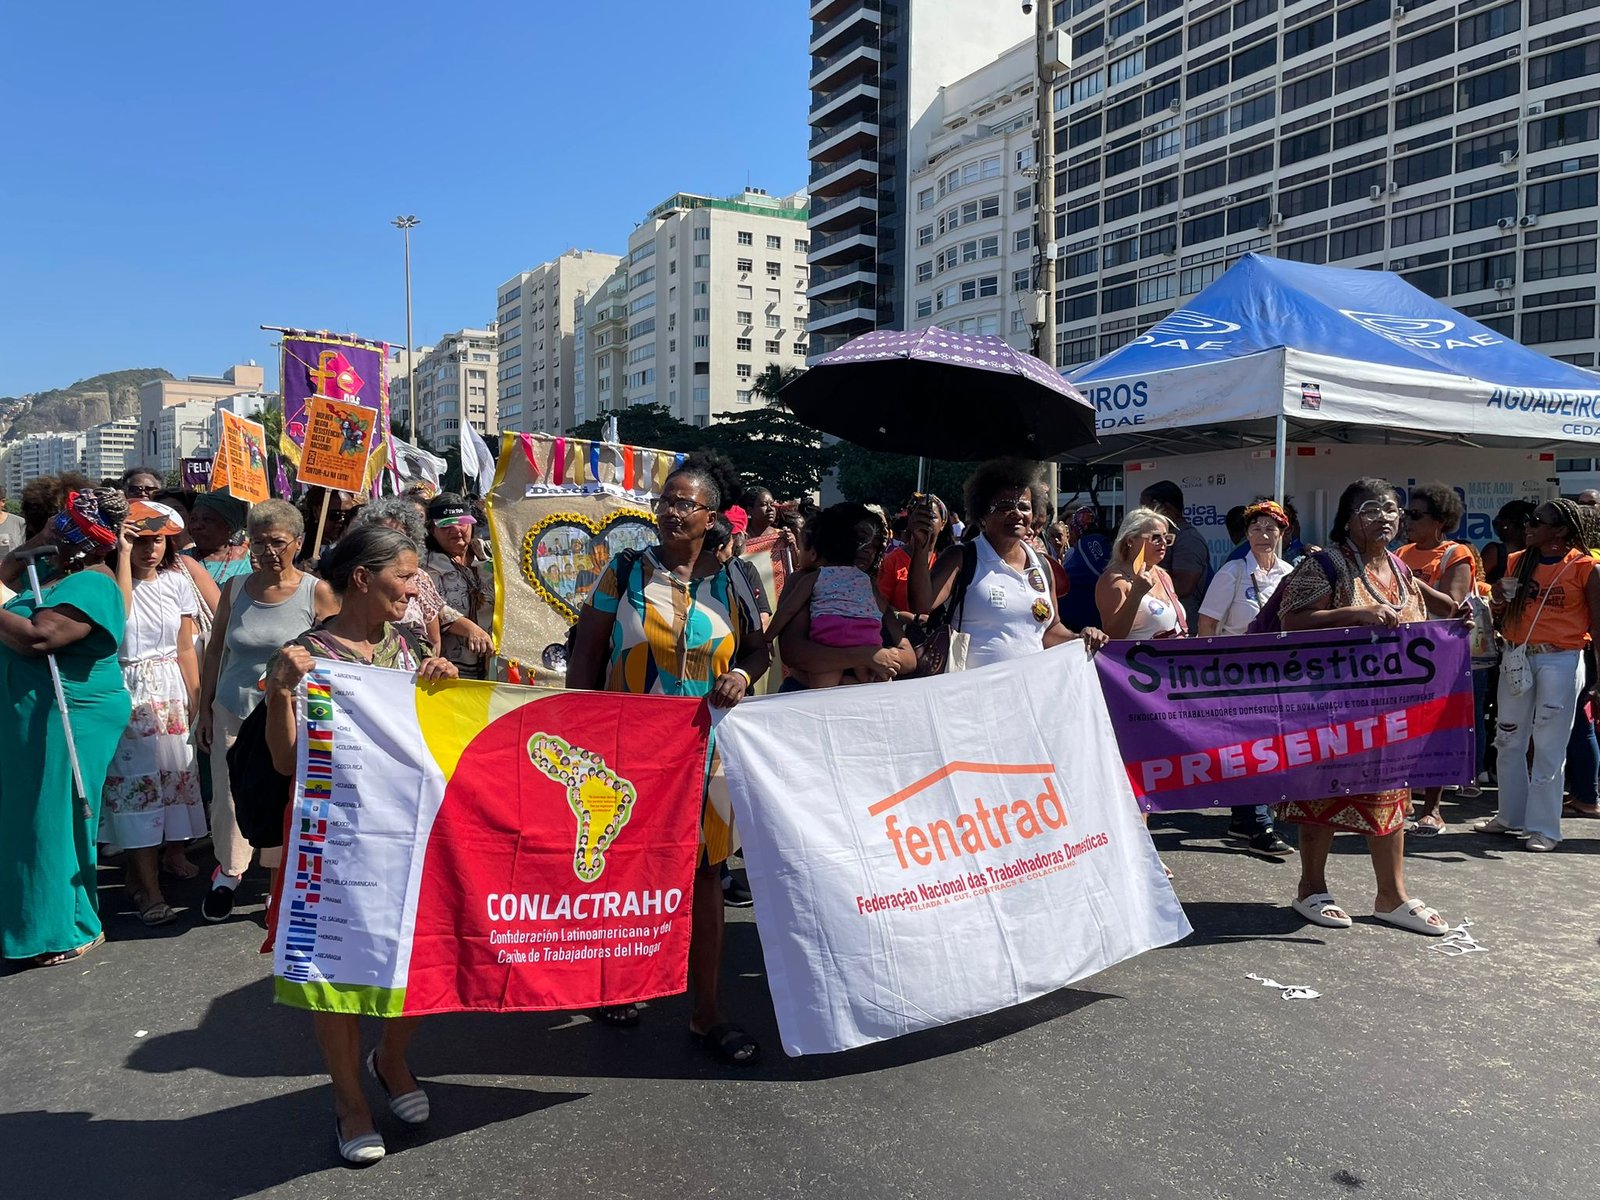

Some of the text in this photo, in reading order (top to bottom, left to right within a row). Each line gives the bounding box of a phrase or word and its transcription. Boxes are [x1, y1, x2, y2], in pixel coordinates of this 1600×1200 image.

[1128, 712, 1167, 722] SINDICATO
[1168, 712, 1177, 720] DE
[1286, 704, 1296, 712] DE
[1140, 709, 1409, 793] PRESENTE
[885, 776, 1069, 870] fenatrad
[856, 831, 1109, 916] Federação Nacional das Trabalhadoras Domésticas
[486, 888, 683, 921] CONLACTRAHO
[560, 925, 650, 942] Latinoamericana
[652, 926, 660, 940] y
[660, 920, 672, 934] del
[497, 941, 662, 964] Caribe de Trabajadoras del Hogar
